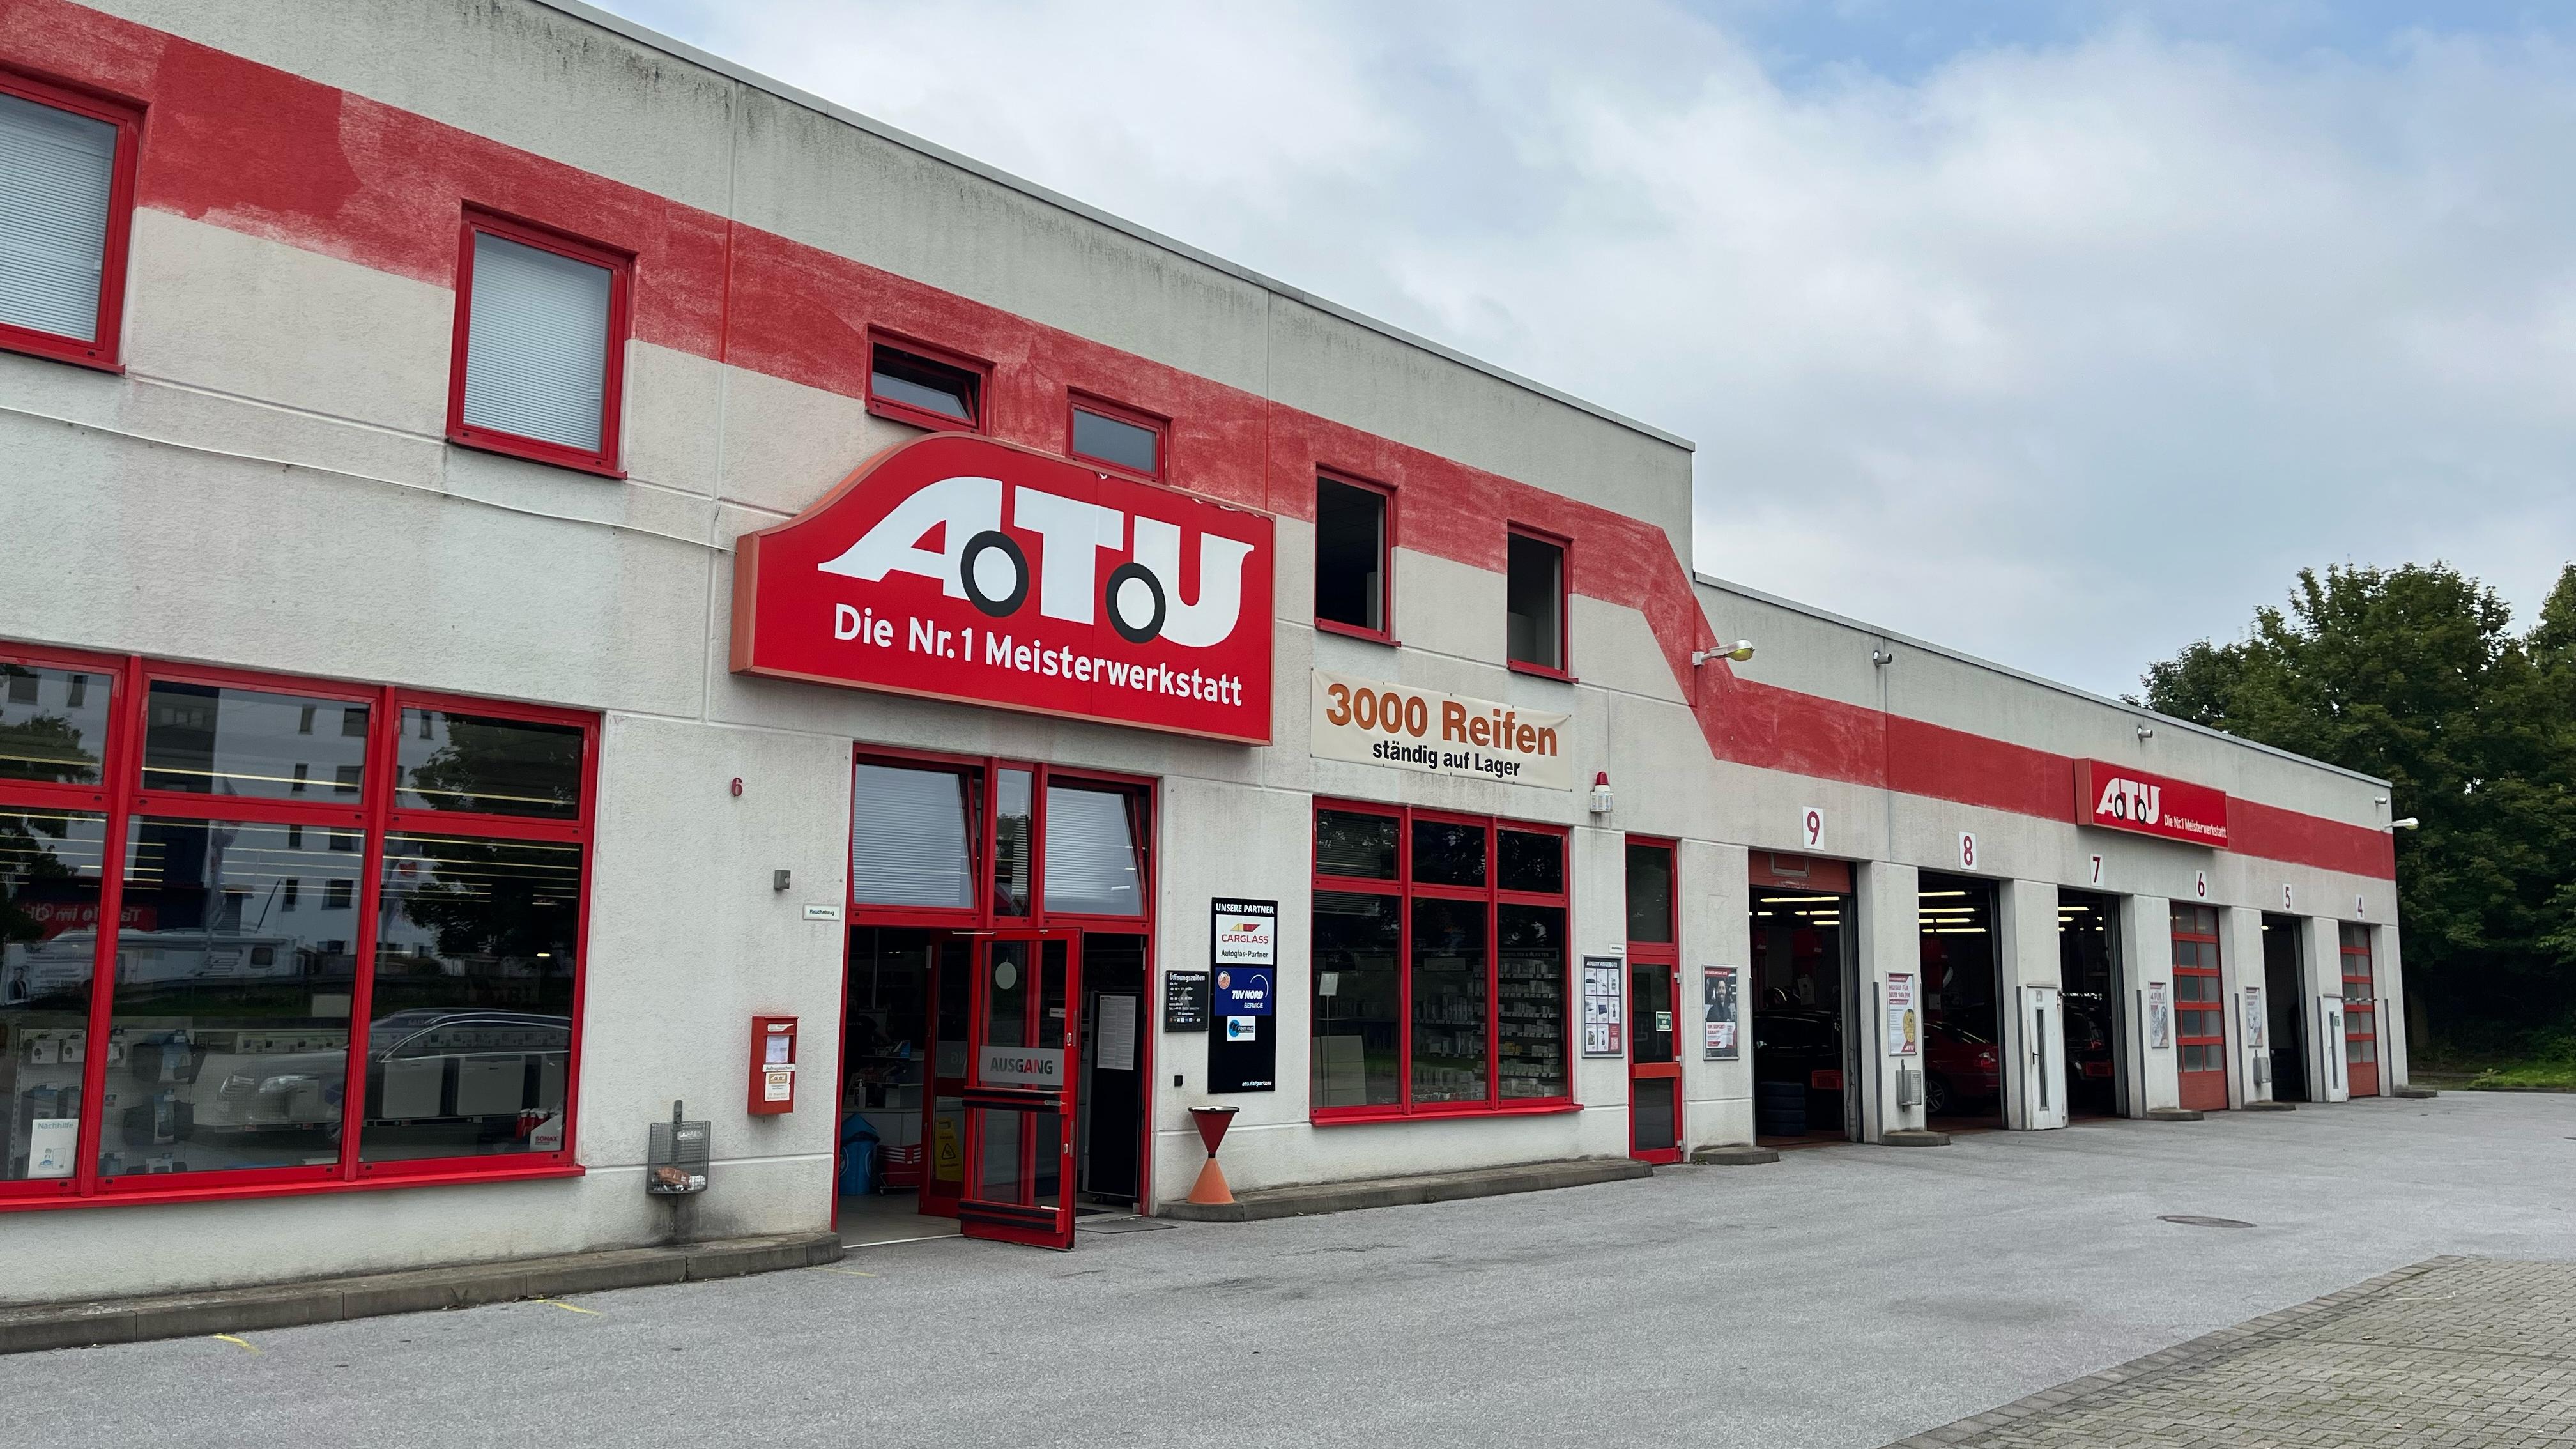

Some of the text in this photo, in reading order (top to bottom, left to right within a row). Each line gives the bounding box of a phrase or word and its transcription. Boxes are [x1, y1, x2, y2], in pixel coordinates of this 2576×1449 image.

[835, 603, 1242, 707] Die Nr.1 Meisterwerkstatt
[1326, 683, 1558, 756] 3000 Reifen
[1373, 740, 1520, 778] ständig auf Lager
[1807, 811, 1820, 845] 9
[2165, 814, 2173, 827] Die
[2174, 816, 2184, 829] Nr.1
[2185, 818, 2227, 838] Meisterwerkstatt
[1963, 838, 1974, 865] 8
[2092, 857, 2101, 882] 7
[2197, 872, 2205, 896] 6
[2284, 886, 2291, 907] 5
[2356, 898, 2363, 916] 4
[1216, 903, 1274, 914] UNSERE PARTNER
[1222, 934, 1269, 944] CARGLASS
[1221, 949, 1268, 958] Autoglas-Partner
[1169, 972, 1205, 983] Öffnungszeiten
[1232, 990, 1264, 999] TÜV NORD
[990, 1057, 1053, 1075] AUSGANG
